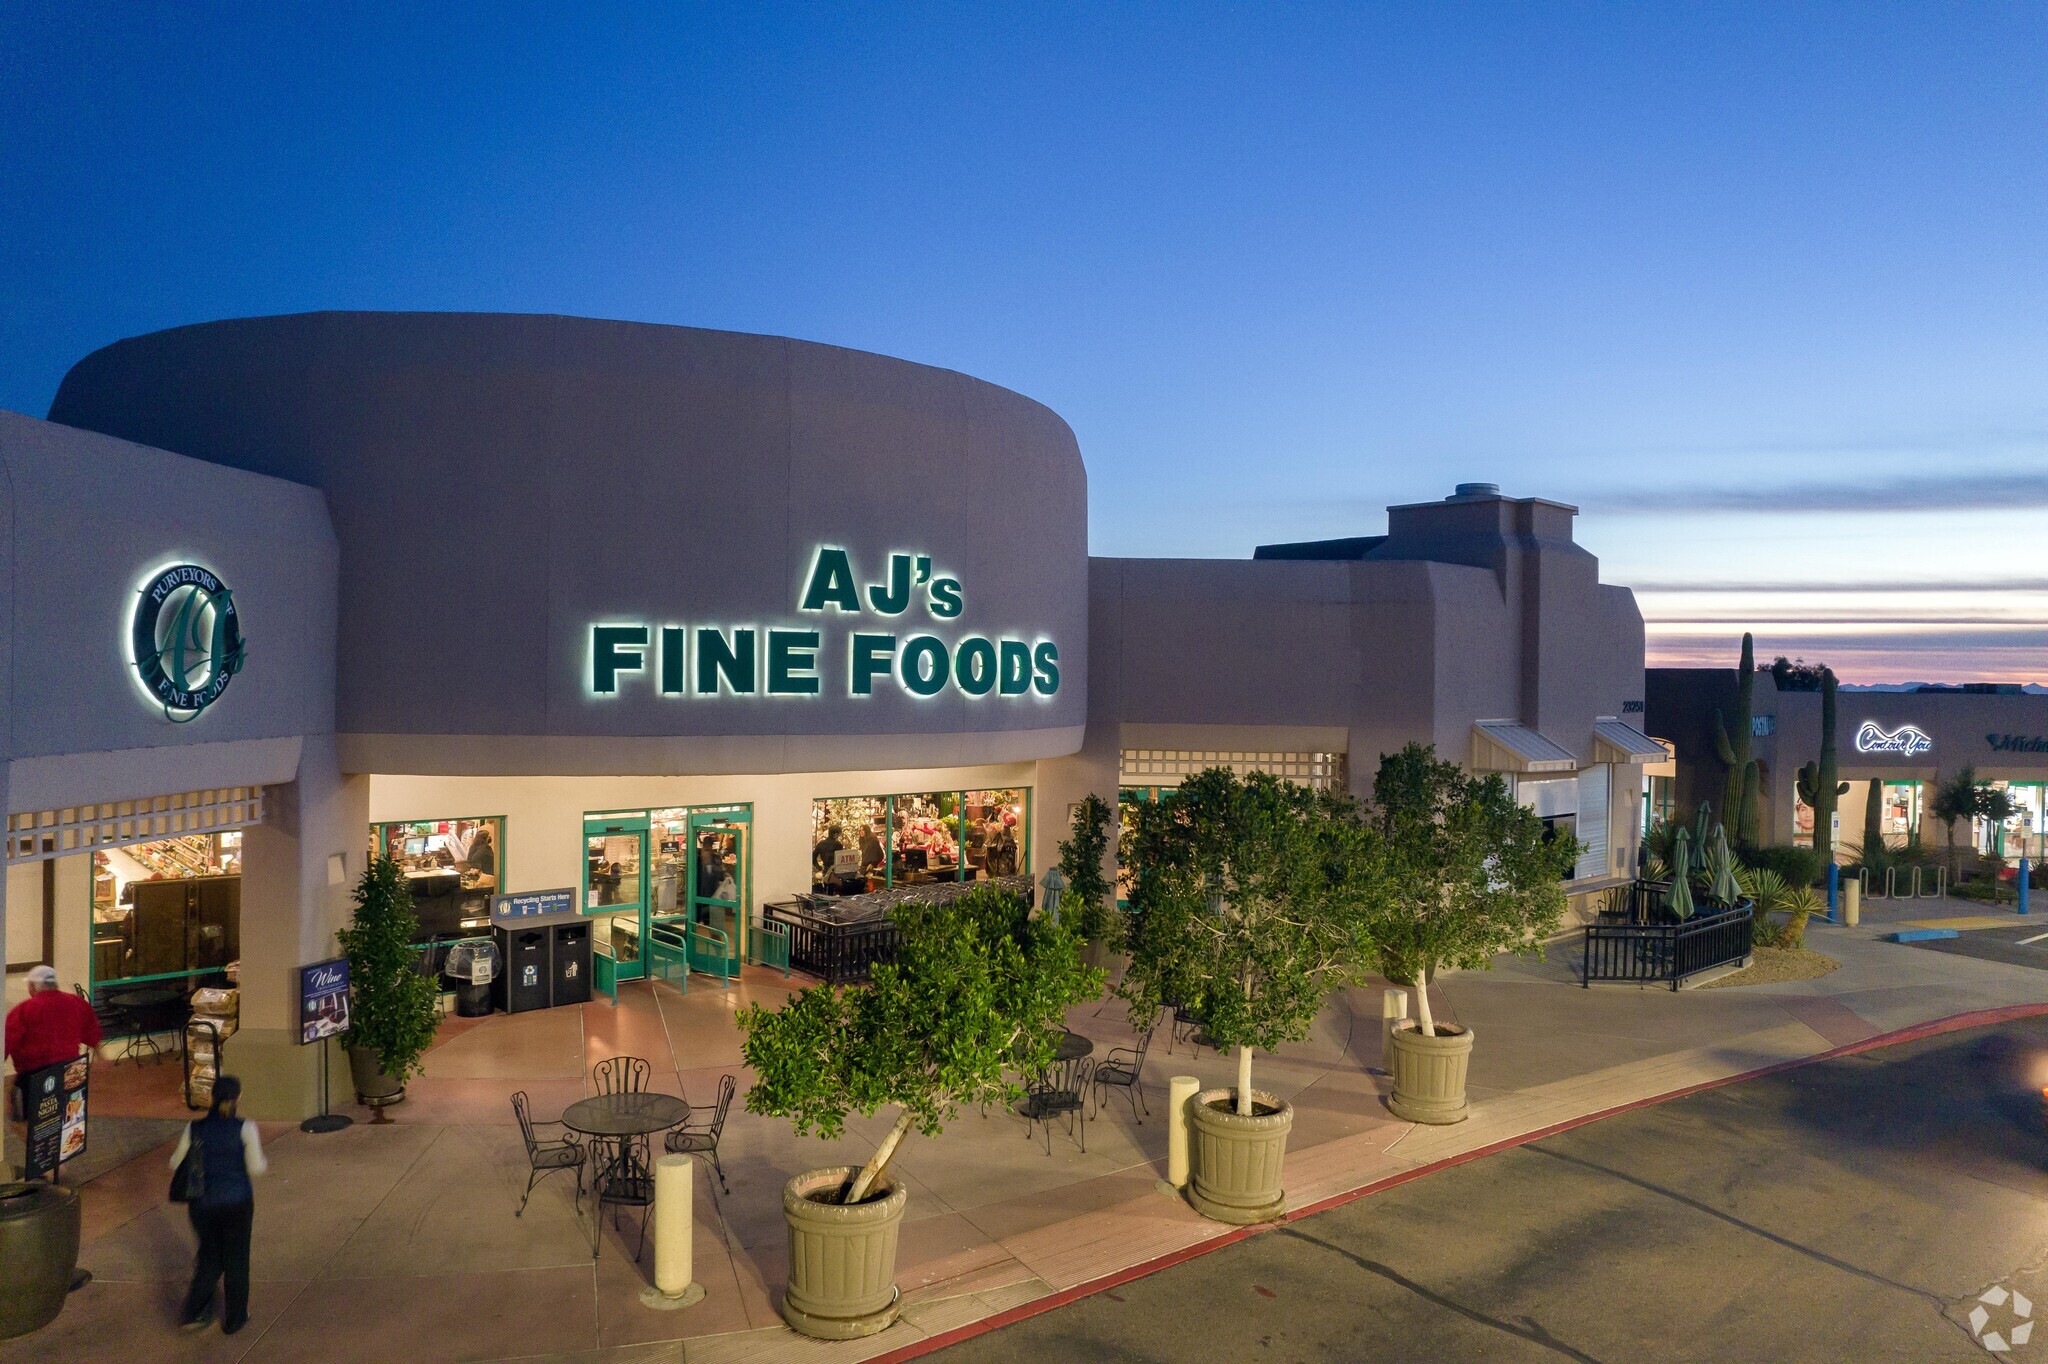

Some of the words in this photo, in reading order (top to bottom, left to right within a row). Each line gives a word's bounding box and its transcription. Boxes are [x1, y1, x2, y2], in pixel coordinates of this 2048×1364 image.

[152, 567, 218, 603] PURVEYORS
[801, 547, 963, 618] AJ's
[592, 626, 820, 694] FINE
[852, 634, 1060, 696] FOODS
[158, 677, 188, 707] FNE
[1899, 729, 1932, 756] You
[841, 855, 855, 863] ATM
[513, 895, 539, 904] Recycling
[540, 894, 557, 902] Starts
[311, 967, 342, 988] Wine
[38, 1103, 58, 1118] NIGHT
[40, 1098, 58, 1110] PASTA
